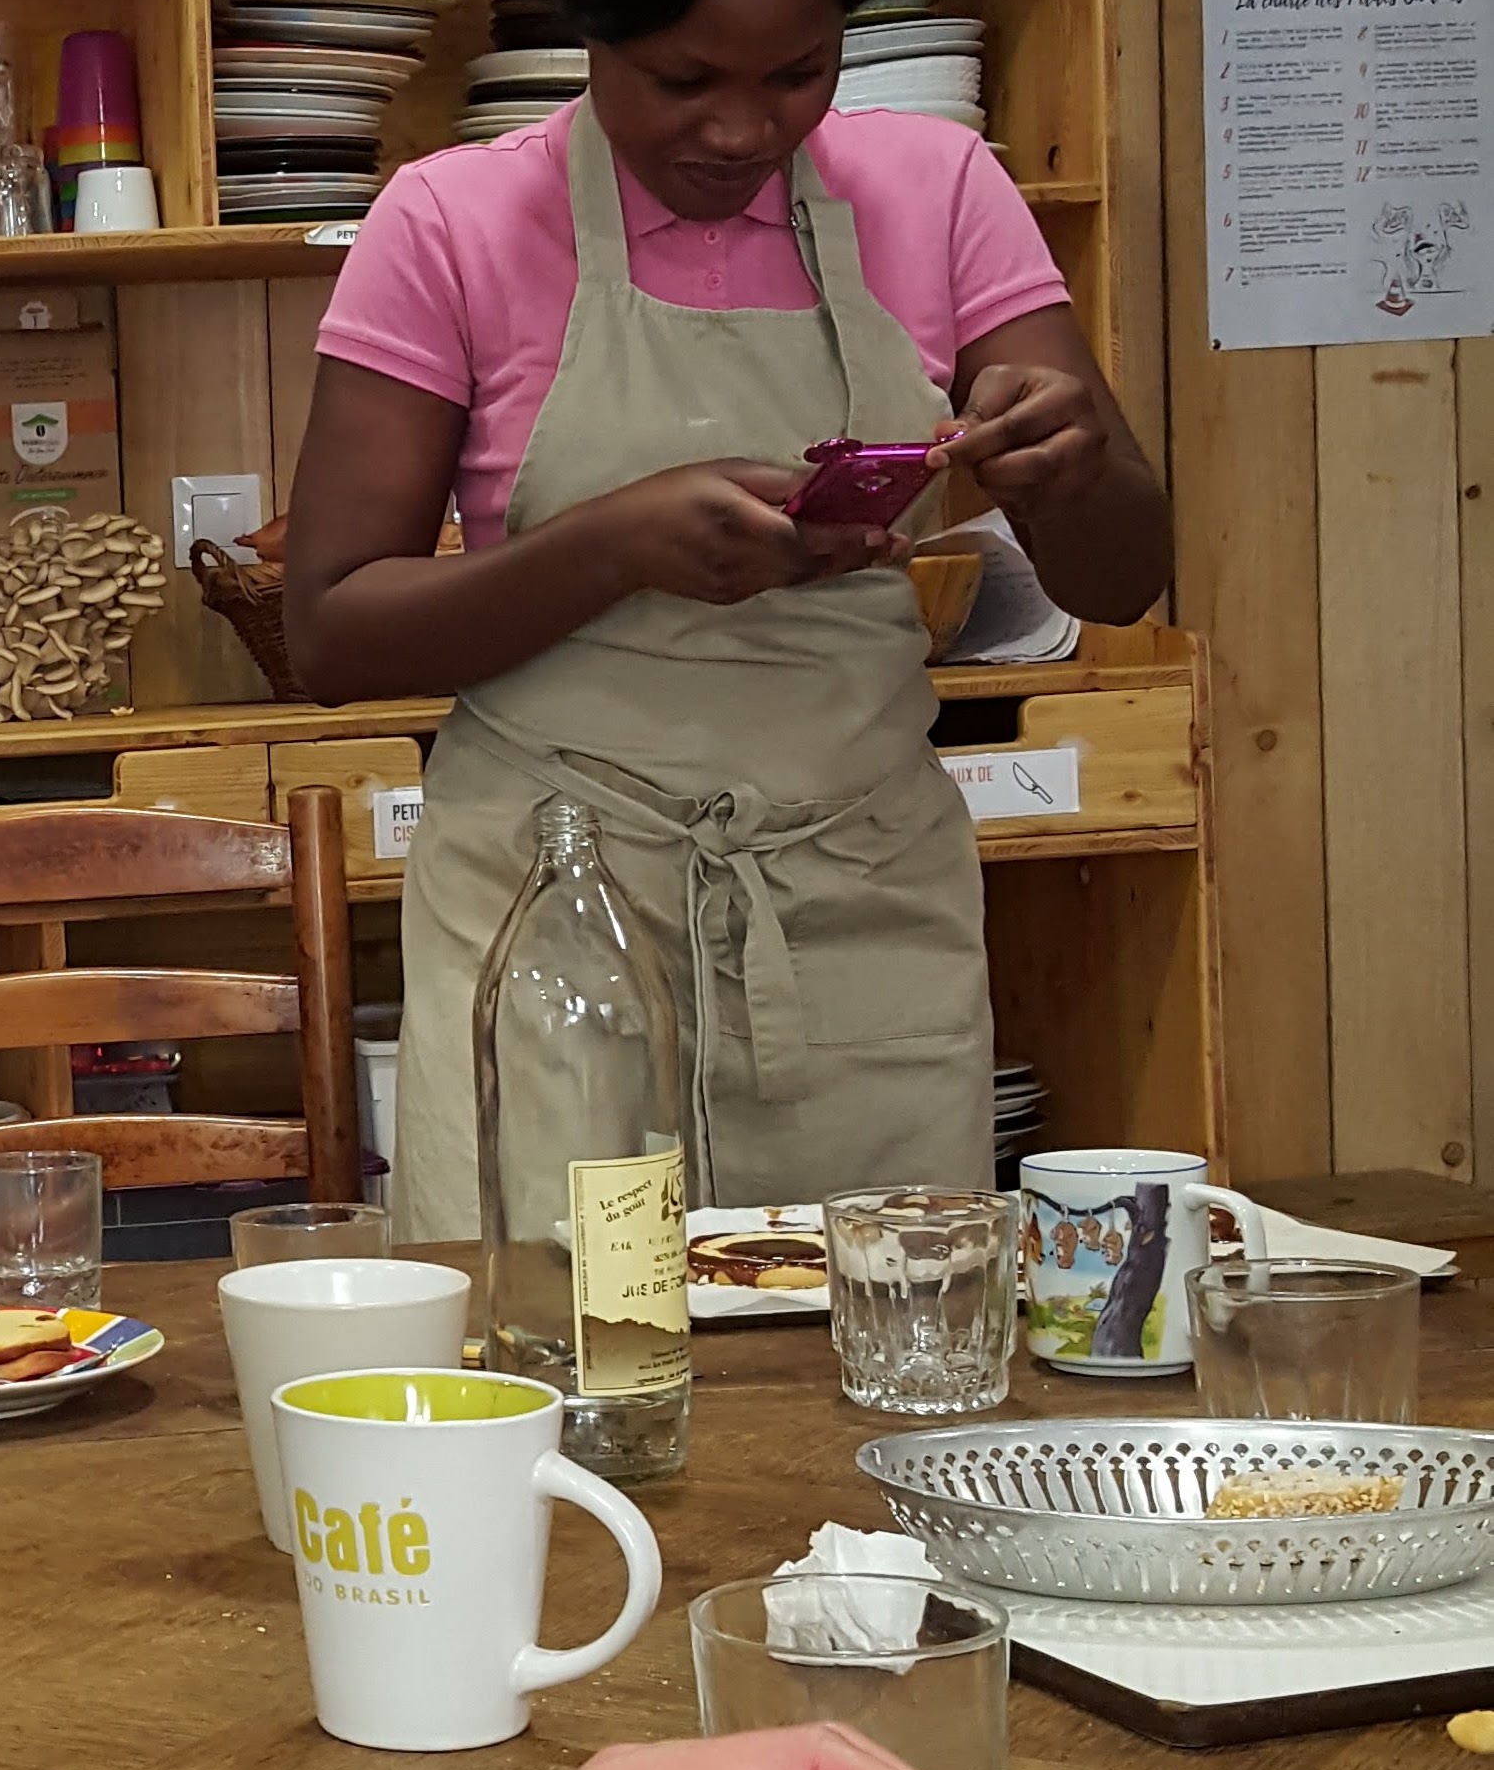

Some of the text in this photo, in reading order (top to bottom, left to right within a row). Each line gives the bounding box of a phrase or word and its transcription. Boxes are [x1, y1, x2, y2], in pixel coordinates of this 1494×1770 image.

[978, 765, 993, 782] DE
[599, 1179, 653, 1210] Le respect
[606, 1212, 621, 1223] du
[622, 1283, 647, 1299] JUS
[653, 1279, 668, 1294] DE
[295, 1487, 431, 1575] Café
[334, 1583, 431, 1606] BRASIL
